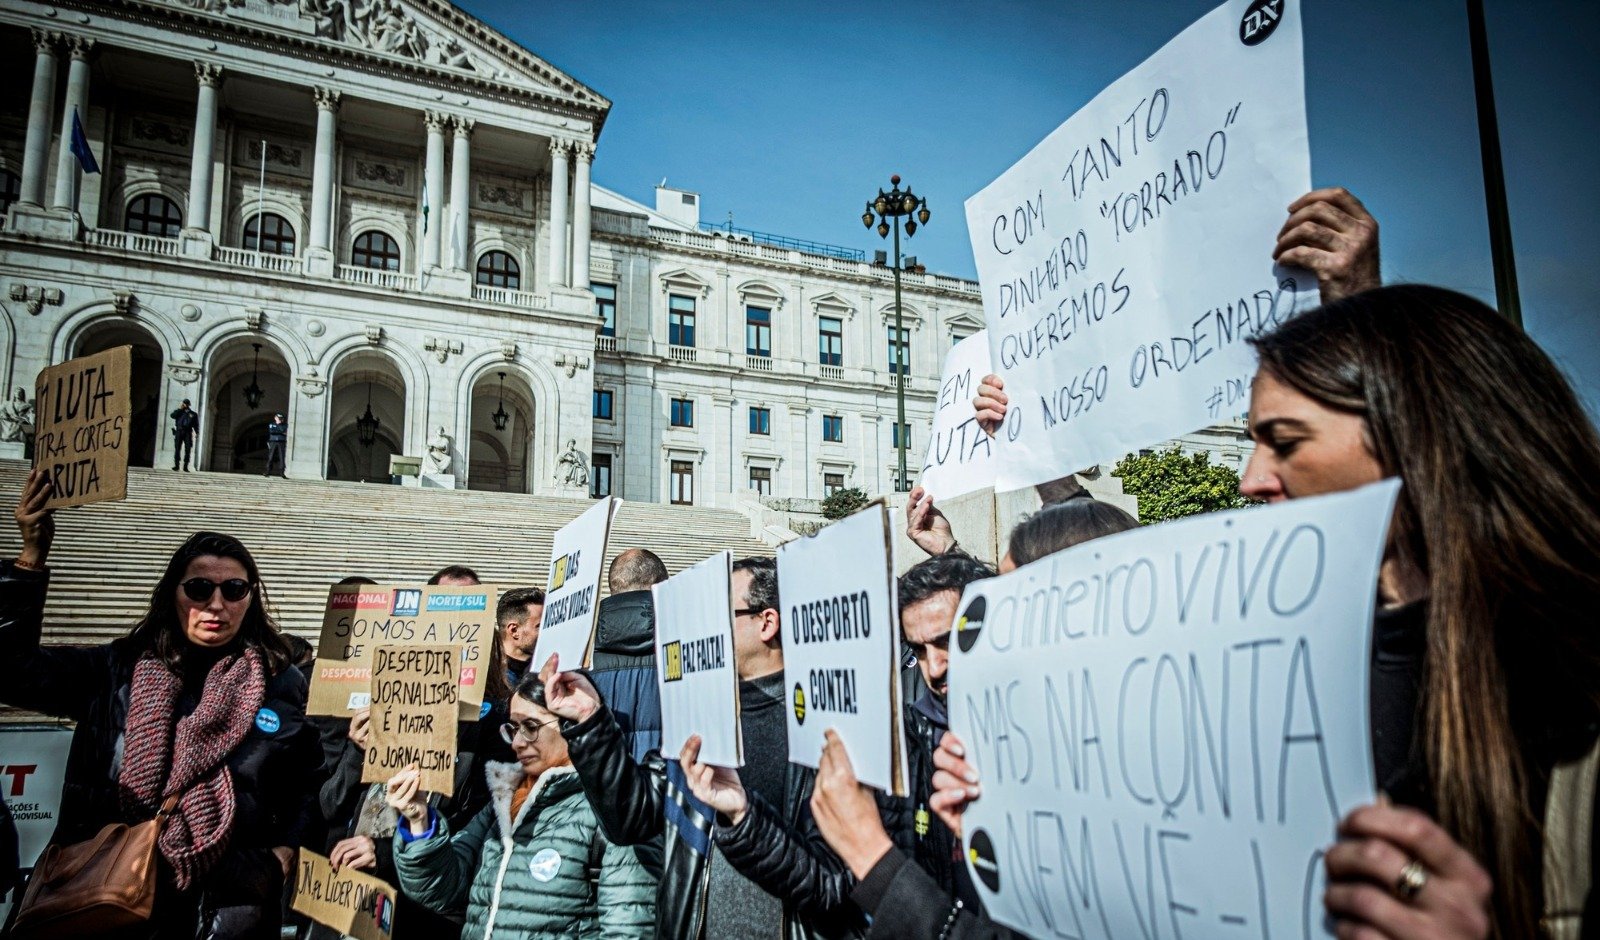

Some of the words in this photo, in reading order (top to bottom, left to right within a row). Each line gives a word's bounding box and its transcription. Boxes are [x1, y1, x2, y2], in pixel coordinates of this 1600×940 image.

[993, 189, 1045, 255] COM
[1062, 87, 1169, 202] TANTO
[1000, 267, 1130, 370] QUEREMOS
[1007, 406, 1021, 442] O
[1042, 365, 1108, 430] NOSSO
[1129, 277, 1297, 389] ORDENADO
[54, 364, 114, 425] LUTA
[940, 368, 970, 411] EM
[74, 415, 124, 453] CORTES
[922, 416, 991, 472] LUTA
[333, 593, 387, 604] NACIONAL
[396, 590, 420, 609] JN
[427, 595, 485, 607] NORTE/SUL
[792, 605, 800, 645] O
[801, 590, 870, 643] DESPORTO
[335, 616, 416, 640] SOMOS
[423, 622, 437, 642] A
[449, 621, 481, 643] VOZ
[342, 645, 365, 660] DE
[375, 649, 452, 679] DESPEDIR
[682, 641, 696, 674] FAZ
[697, 634, 725, 672] FALTA!
[372, 680, 457, 706] JORNALISTAS
[810, 668, 857, 714] CONTA!
[383, 704, 392, 732] É
[398, 714, 434, 733] MATAR
[966, 679, 1033, 785] MAS
[1044, 668, 1113, 799] NA
[1117, 637, 1342, 824] CONTA
[368, 747, 378, 765] O
[381, 746, 452, 772] JORNALISMO
[34, 803, 40, 811] E
[1006, 810, 1112, 940] NEM
